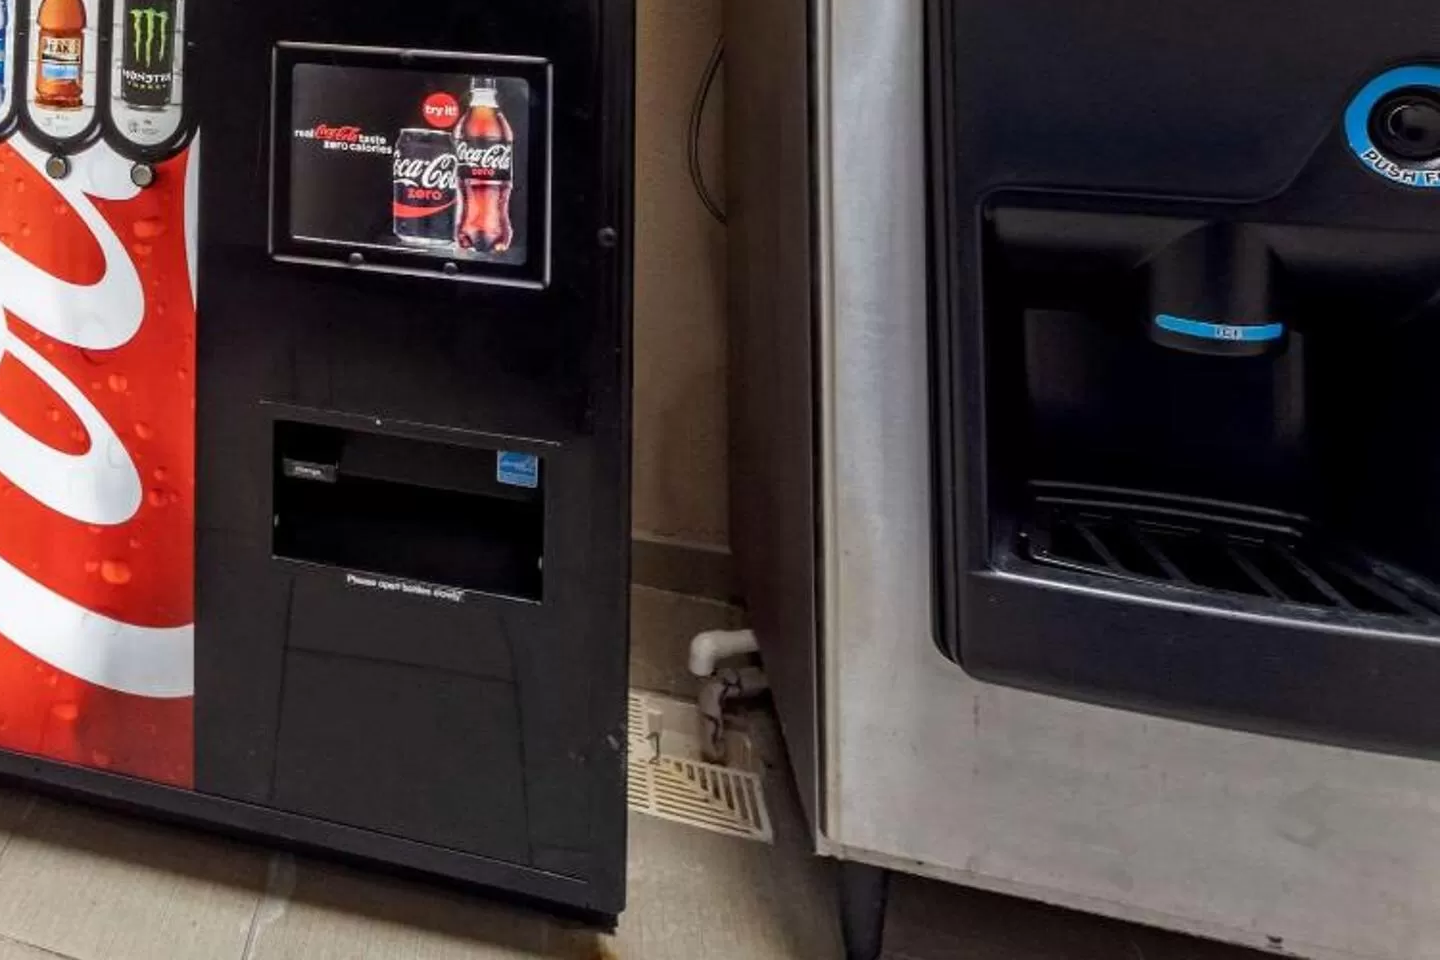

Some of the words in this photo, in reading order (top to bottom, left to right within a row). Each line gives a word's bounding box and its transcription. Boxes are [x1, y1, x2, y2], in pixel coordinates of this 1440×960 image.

[424, 104, 442, 117] try
[444, 104, 459, 116] it!
[294, 128, 314, 139] real
[314, 123, 361, 143] Coca-Cola
[359, 134, 387, 145] taste
[323, 140, 348, 150] zero
[349, 142, 393, 155] calories
[1362, 148, 1417, 183] PUSH
[407, 188, 442, 200] zero
